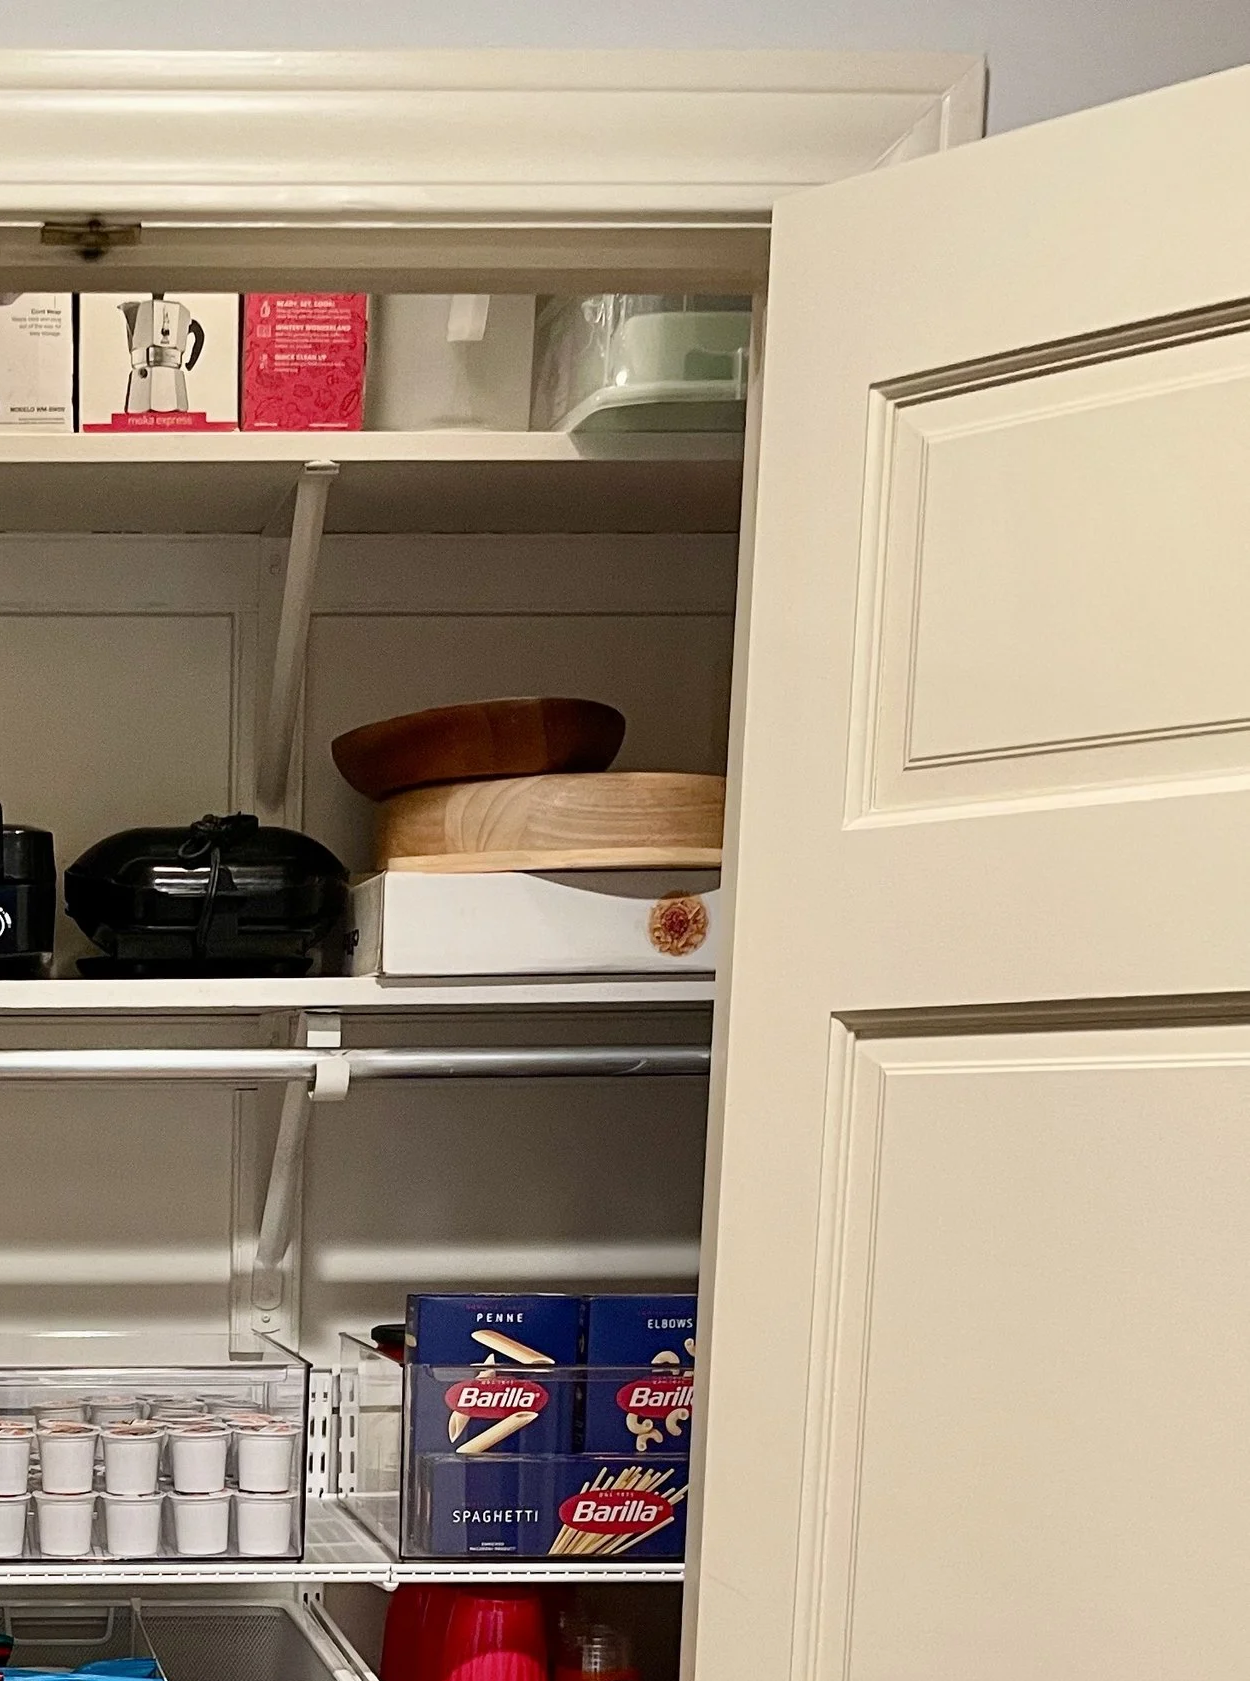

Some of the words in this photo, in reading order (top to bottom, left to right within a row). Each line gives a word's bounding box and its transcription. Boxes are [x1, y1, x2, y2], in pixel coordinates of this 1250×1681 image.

[127, 415, 155, 426] moka
[155, 415, 193, 427] express
[476, 1312, 524, 1323] PENNE
[647, 1318, 694, 1330] ELBOWS
[457, 1386, 536, 1408] Barilla
[452, 1509, 539, 1523] SPAGHETTI
[572, 1499, 658, 1523] Barilla
